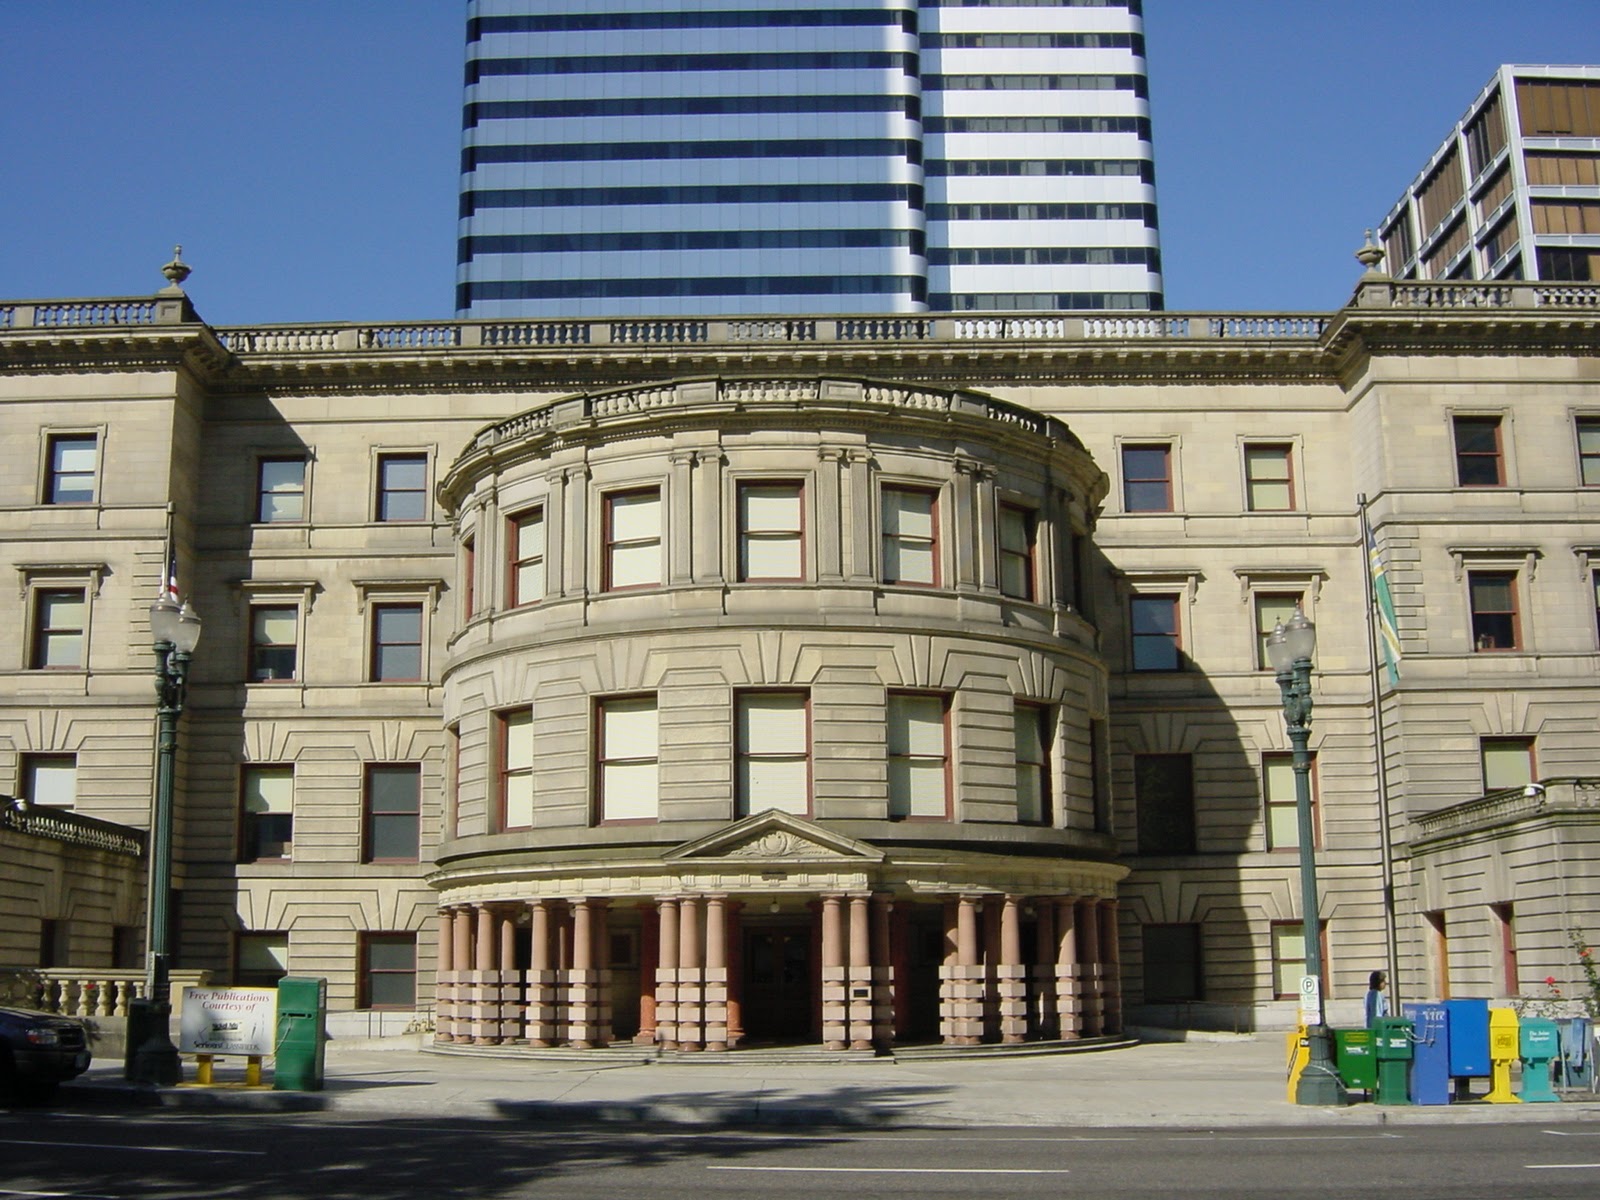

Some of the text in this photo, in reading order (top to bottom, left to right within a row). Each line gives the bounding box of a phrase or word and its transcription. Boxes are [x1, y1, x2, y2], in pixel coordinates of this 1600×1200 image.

[189, 991, 270, 1002] Free Publications
[202, 1001, 256, 1013] Courtesy of
